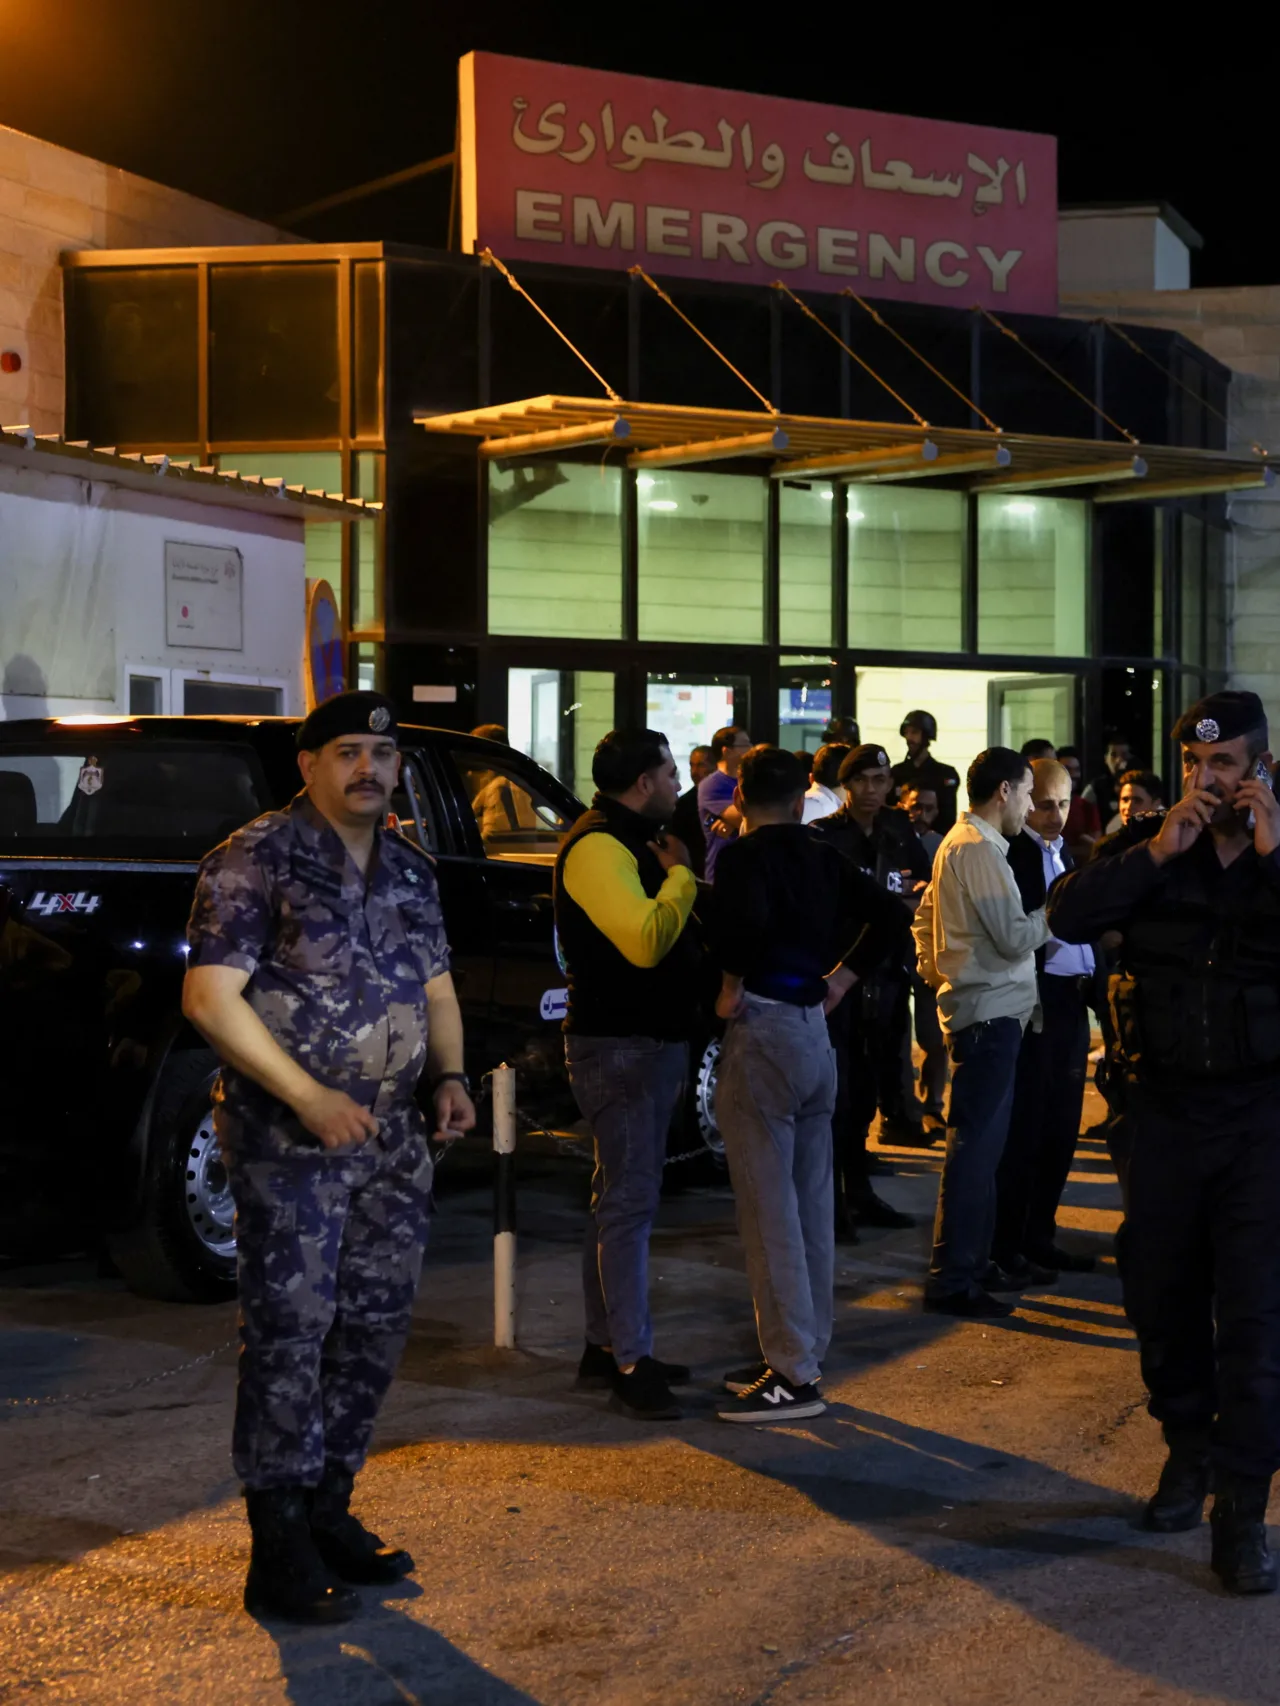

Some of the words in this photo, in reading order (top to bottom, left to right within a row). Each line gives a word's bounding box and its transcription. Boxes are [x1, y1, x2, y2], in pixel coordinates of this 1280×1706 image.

[511, 96, 786, 189] والطوارئ
[803, 132, 1027, 217] الإسعاف
[514, 190, 1023, 292] EMERGENCY
